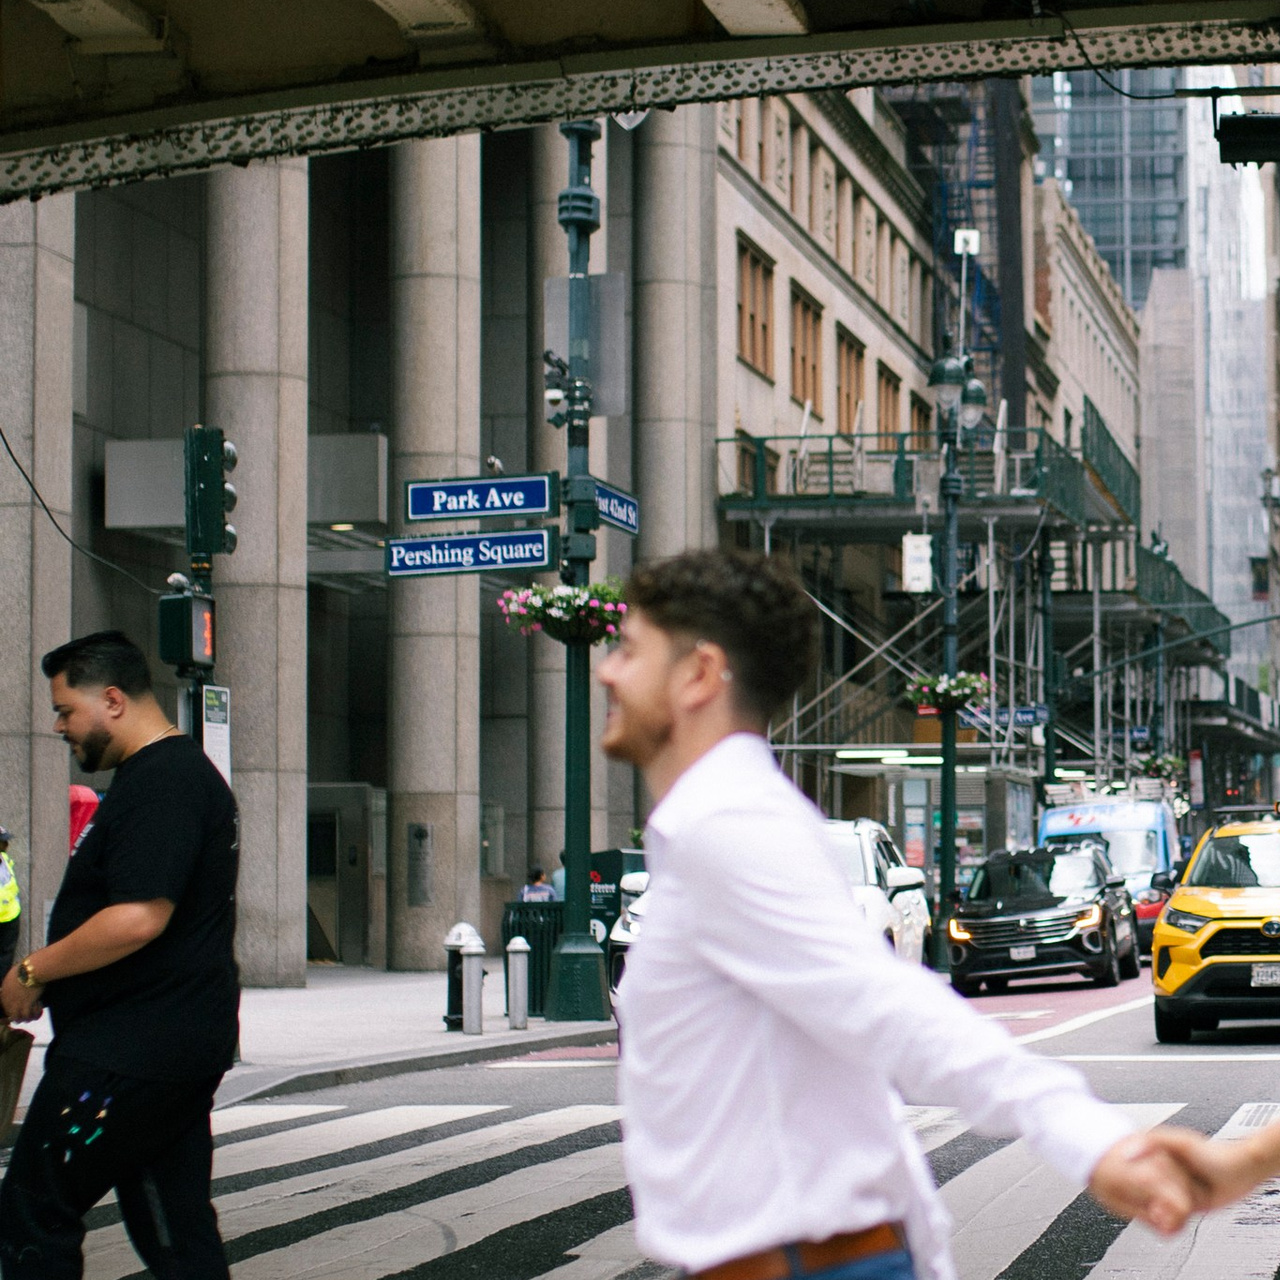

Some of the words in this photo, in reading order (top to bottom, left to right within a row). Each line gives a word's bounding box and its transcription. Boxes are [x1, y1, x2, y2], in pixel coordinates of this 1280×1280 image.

[432, 488, 480, 512] Park
[485, 487, 525, 508] Ave
[609, 499, 627, 522] 42nd
[628, 505, 636, 526] St
[391, 543, 474, 567] Pershing
[479, 540, 544, 565] Square
